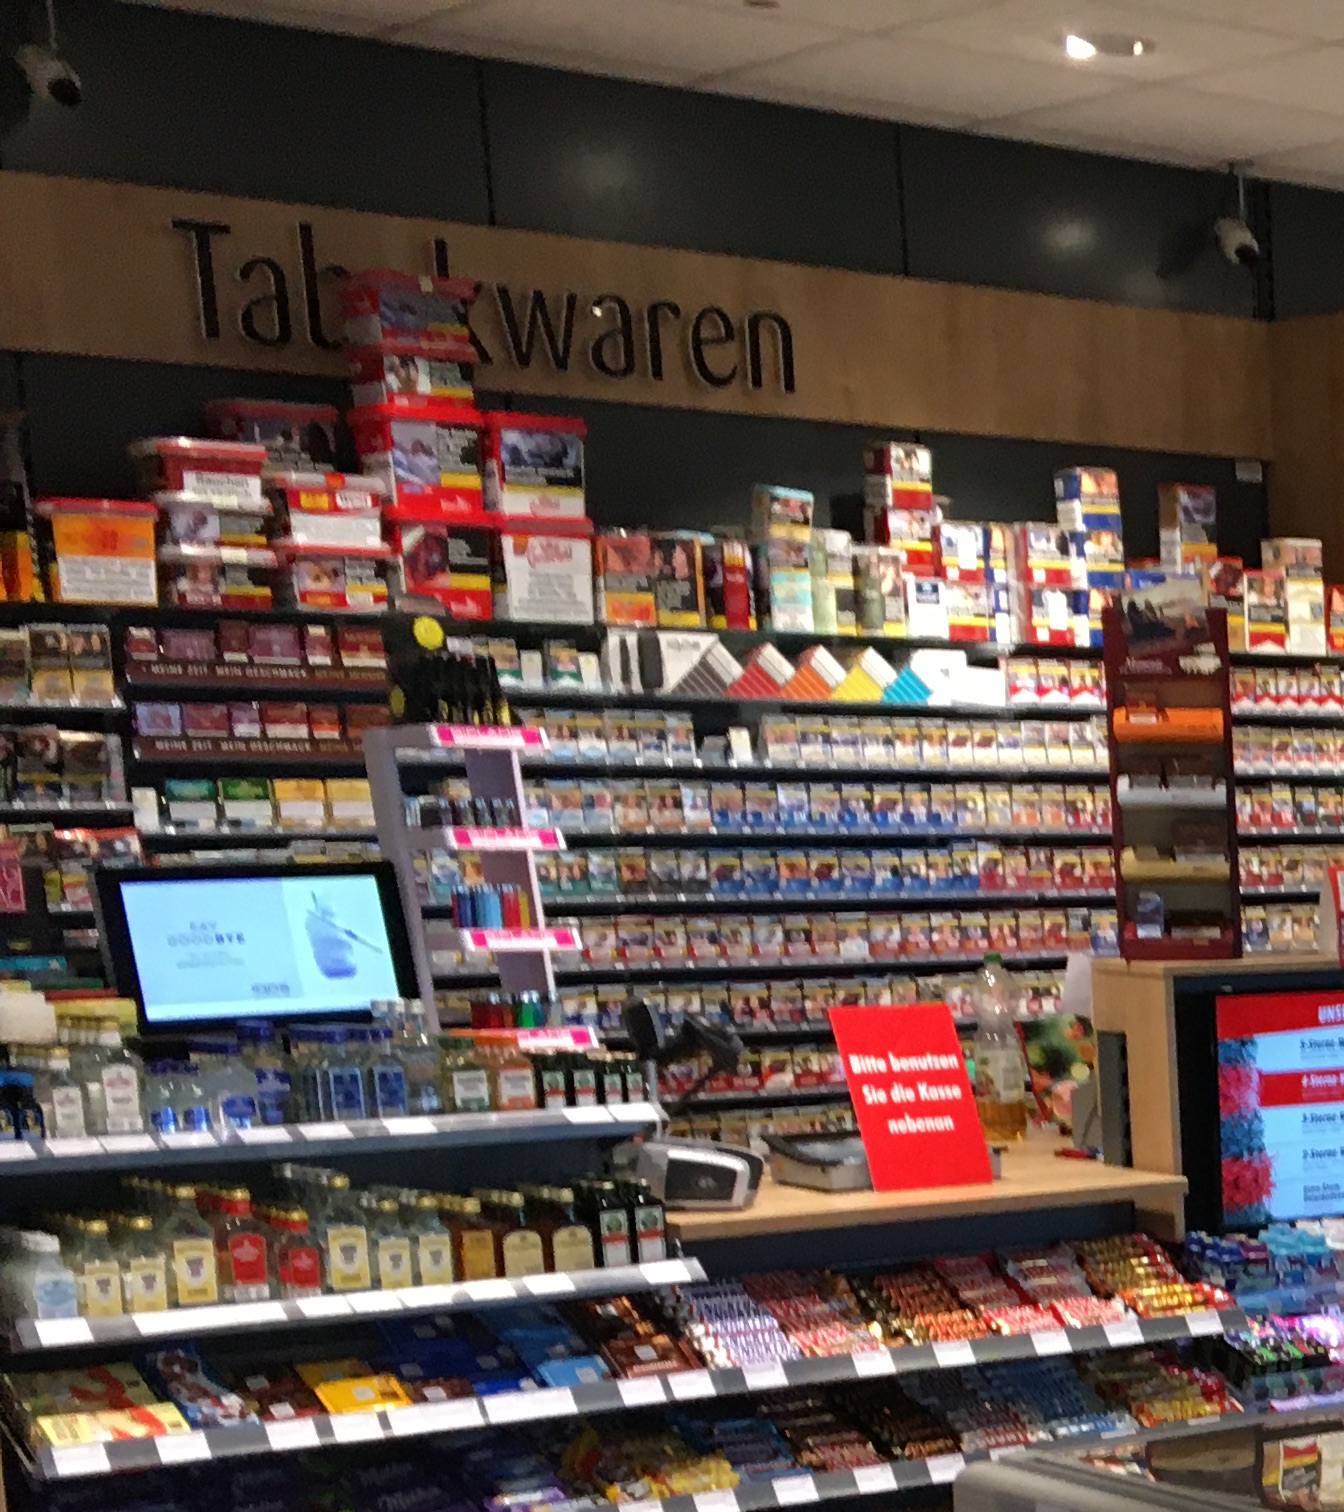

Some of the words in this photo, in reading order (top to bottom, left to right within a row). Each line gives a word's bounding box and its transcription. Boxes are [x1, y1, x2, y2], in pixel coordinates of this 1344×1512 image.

[172, 218, 796, 394] Tabkwaren
[848, 1053, 887, 1075] Bitte
[888, 1050, 959, 1072] benutzen
[861, 1083, 888, 1105] Sie
[890, 1081, 915, 1104] die
[917, 1081, 962, 1101] Kasse
[887, 1111, 954, 1134] nebenan
